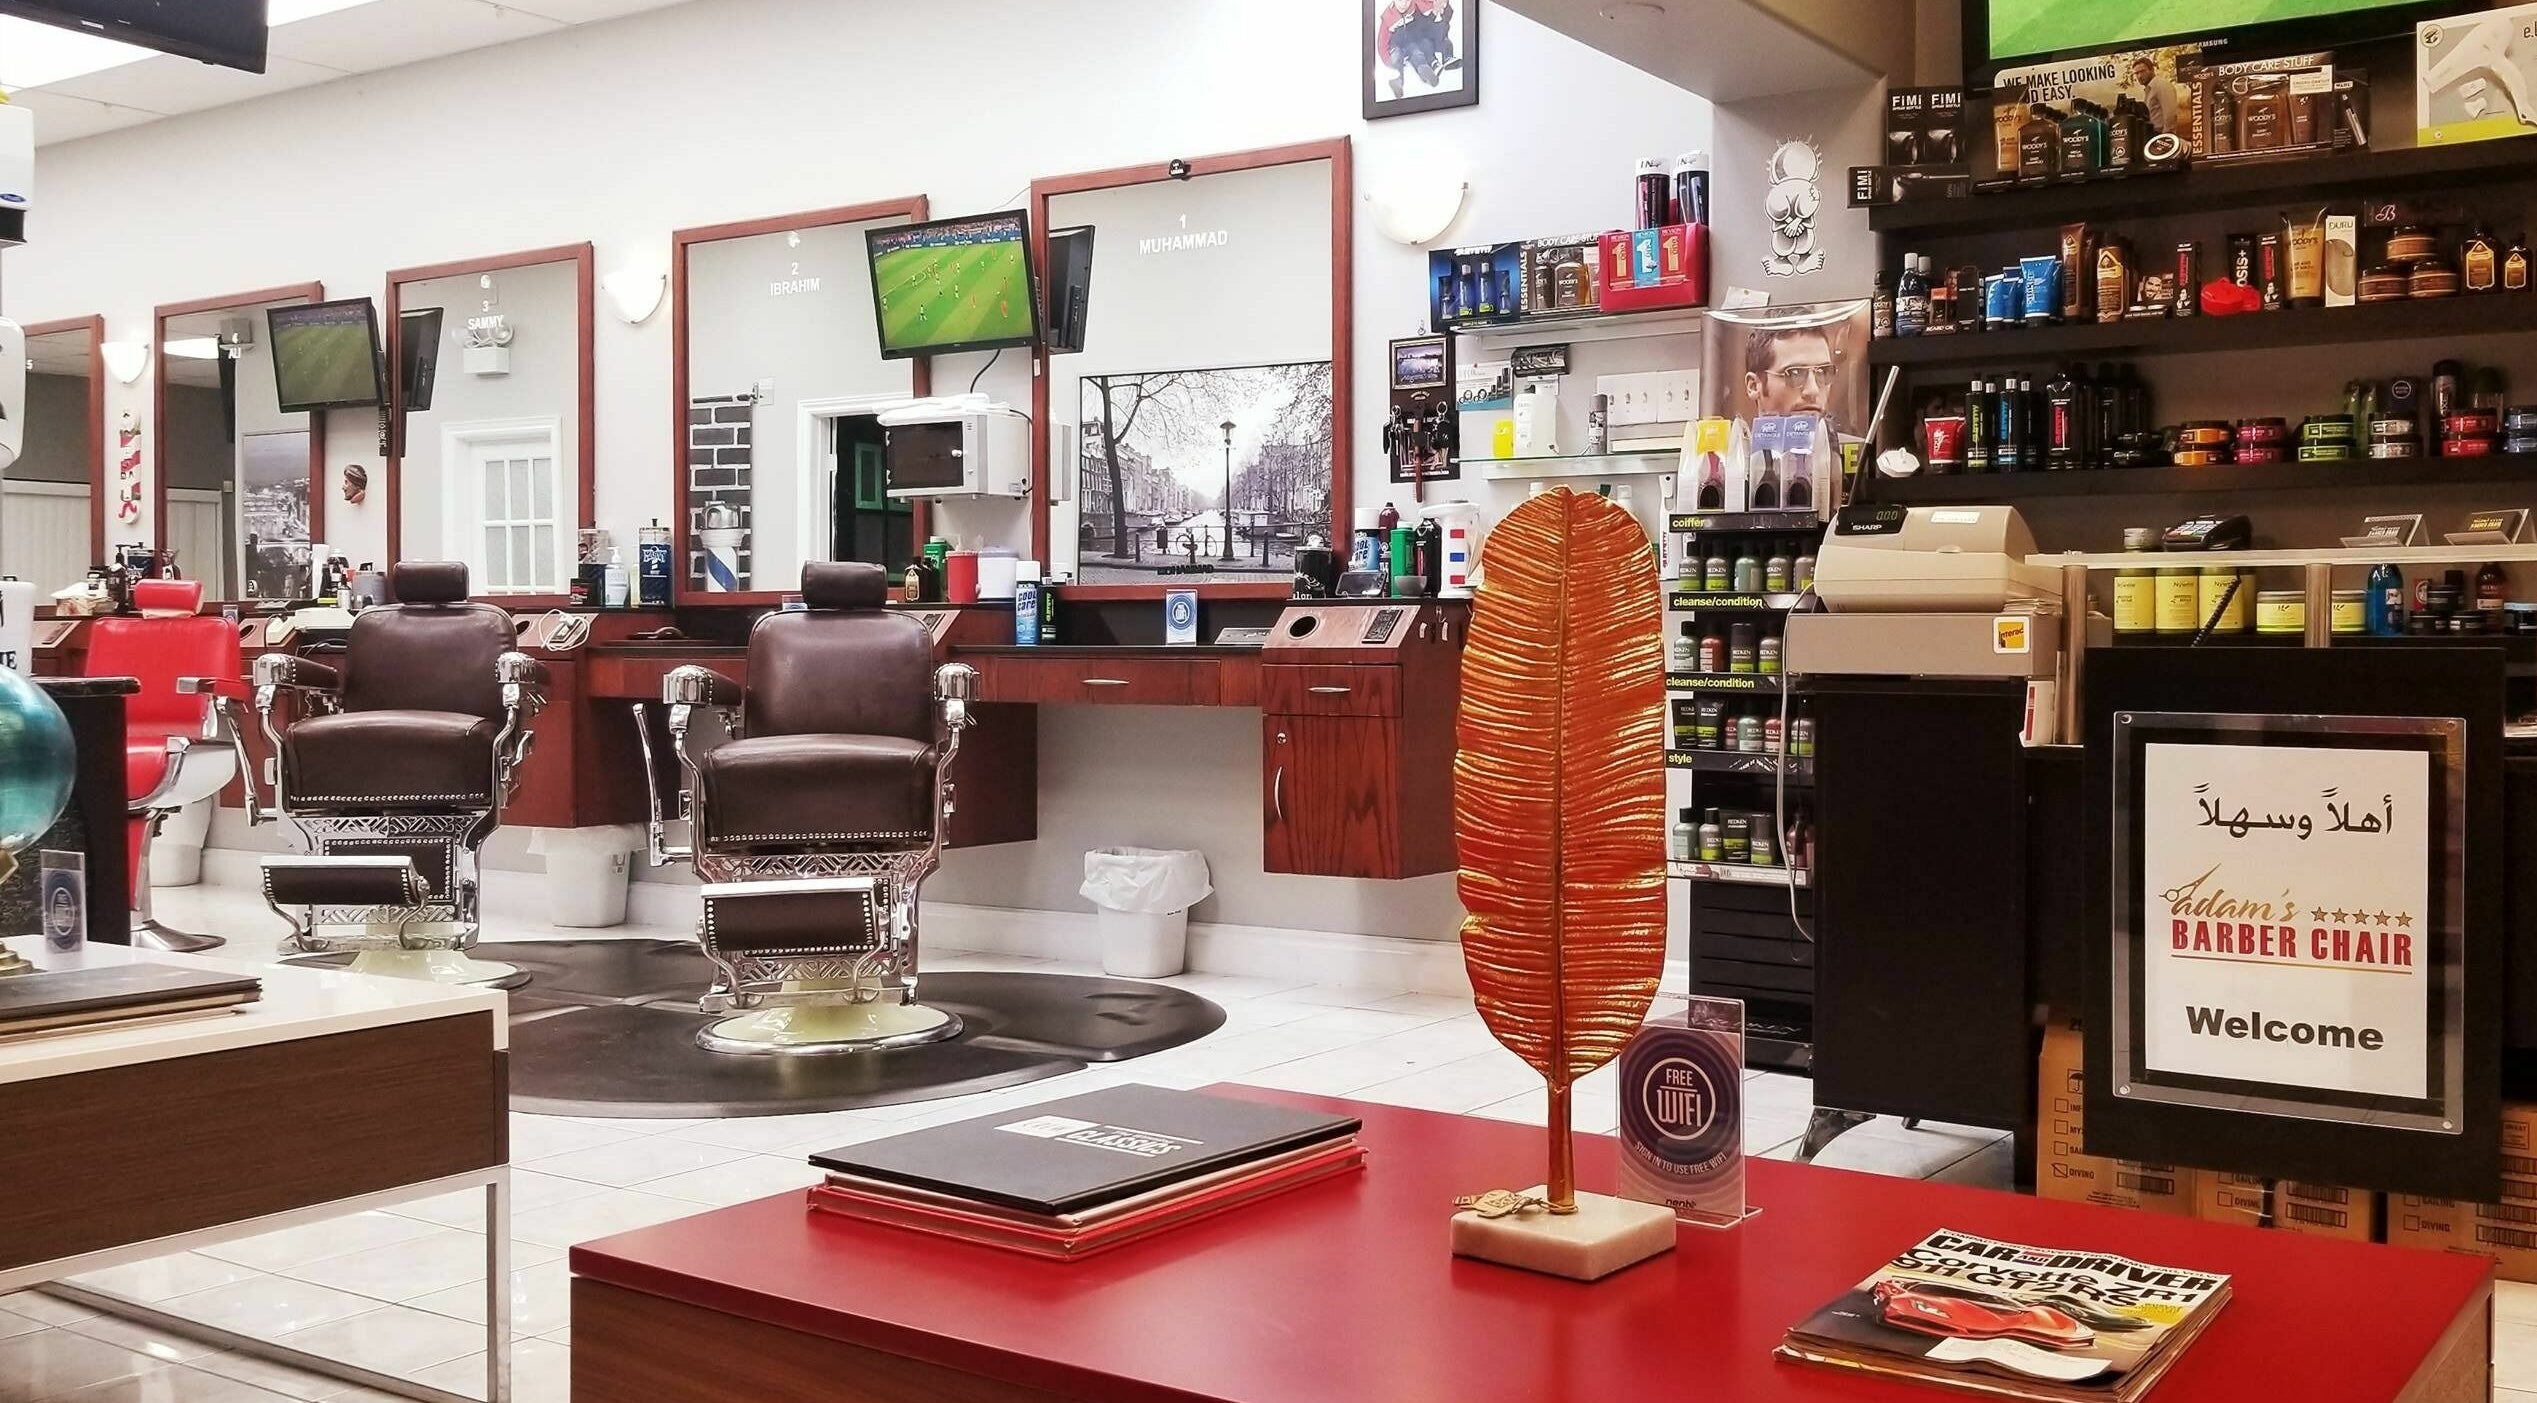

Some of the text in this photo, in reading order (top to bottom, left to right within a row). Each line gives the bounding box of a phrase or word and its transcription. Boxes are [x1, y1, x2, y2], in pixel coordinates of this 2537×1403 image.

[2199, 38, 2228, 47] AMSUNG
[2219, 55, 2314, 76] BODY CARE STUFF
[2027, 71, 2060, 88] MAKE
[2062, 64, 2116, 86] LOOKING
[2042, 86, 2076, 102] EASY.
[2192, 81, 2203, 154] ESSENTIALS
[1179, 213, 1187, 228] 1
[1139, 230, 1228, 255] MUHAMMAD
[791, 262, 799, 275] 2
[770, 277, 821, 297] IBRAHIM
[482, 300, 489, 313] 3
[468, 315, 504, 331] SAMMY
[1672, 517, 1705, 529] coiffer
[1852, 524, 1883, 532] SHARP
[1673, 596, 1763, 608] cleanse/condition
[1666, 676, 1755, 688] cleanse/condition
[1668, 753, 1692, 764] style
[2171, 888, 2300, 923] adam's
[2171, 919, 2413, 966] BARBER CHAIR
[2186, 1005, 2384, 1051] Welcome
[1666, 1068, 1694, 1087] FREE
[1657, 1089, 1702, 1127] WIFI
[1066, 1130, 1183, 1154] CLASSICS
[1634, 1140, 1728, 1175] SIGN IN TO USE FREE WIFI
[2069, 1168, 2095, 1179] DIVING
[1926, 1234, 2218, 1291] CAR AND DRIVER
[1893, 1256, 2140, 1307] 911 GT2 RS
[1906, 1248, 2198, 1303] Corvette ZR1
